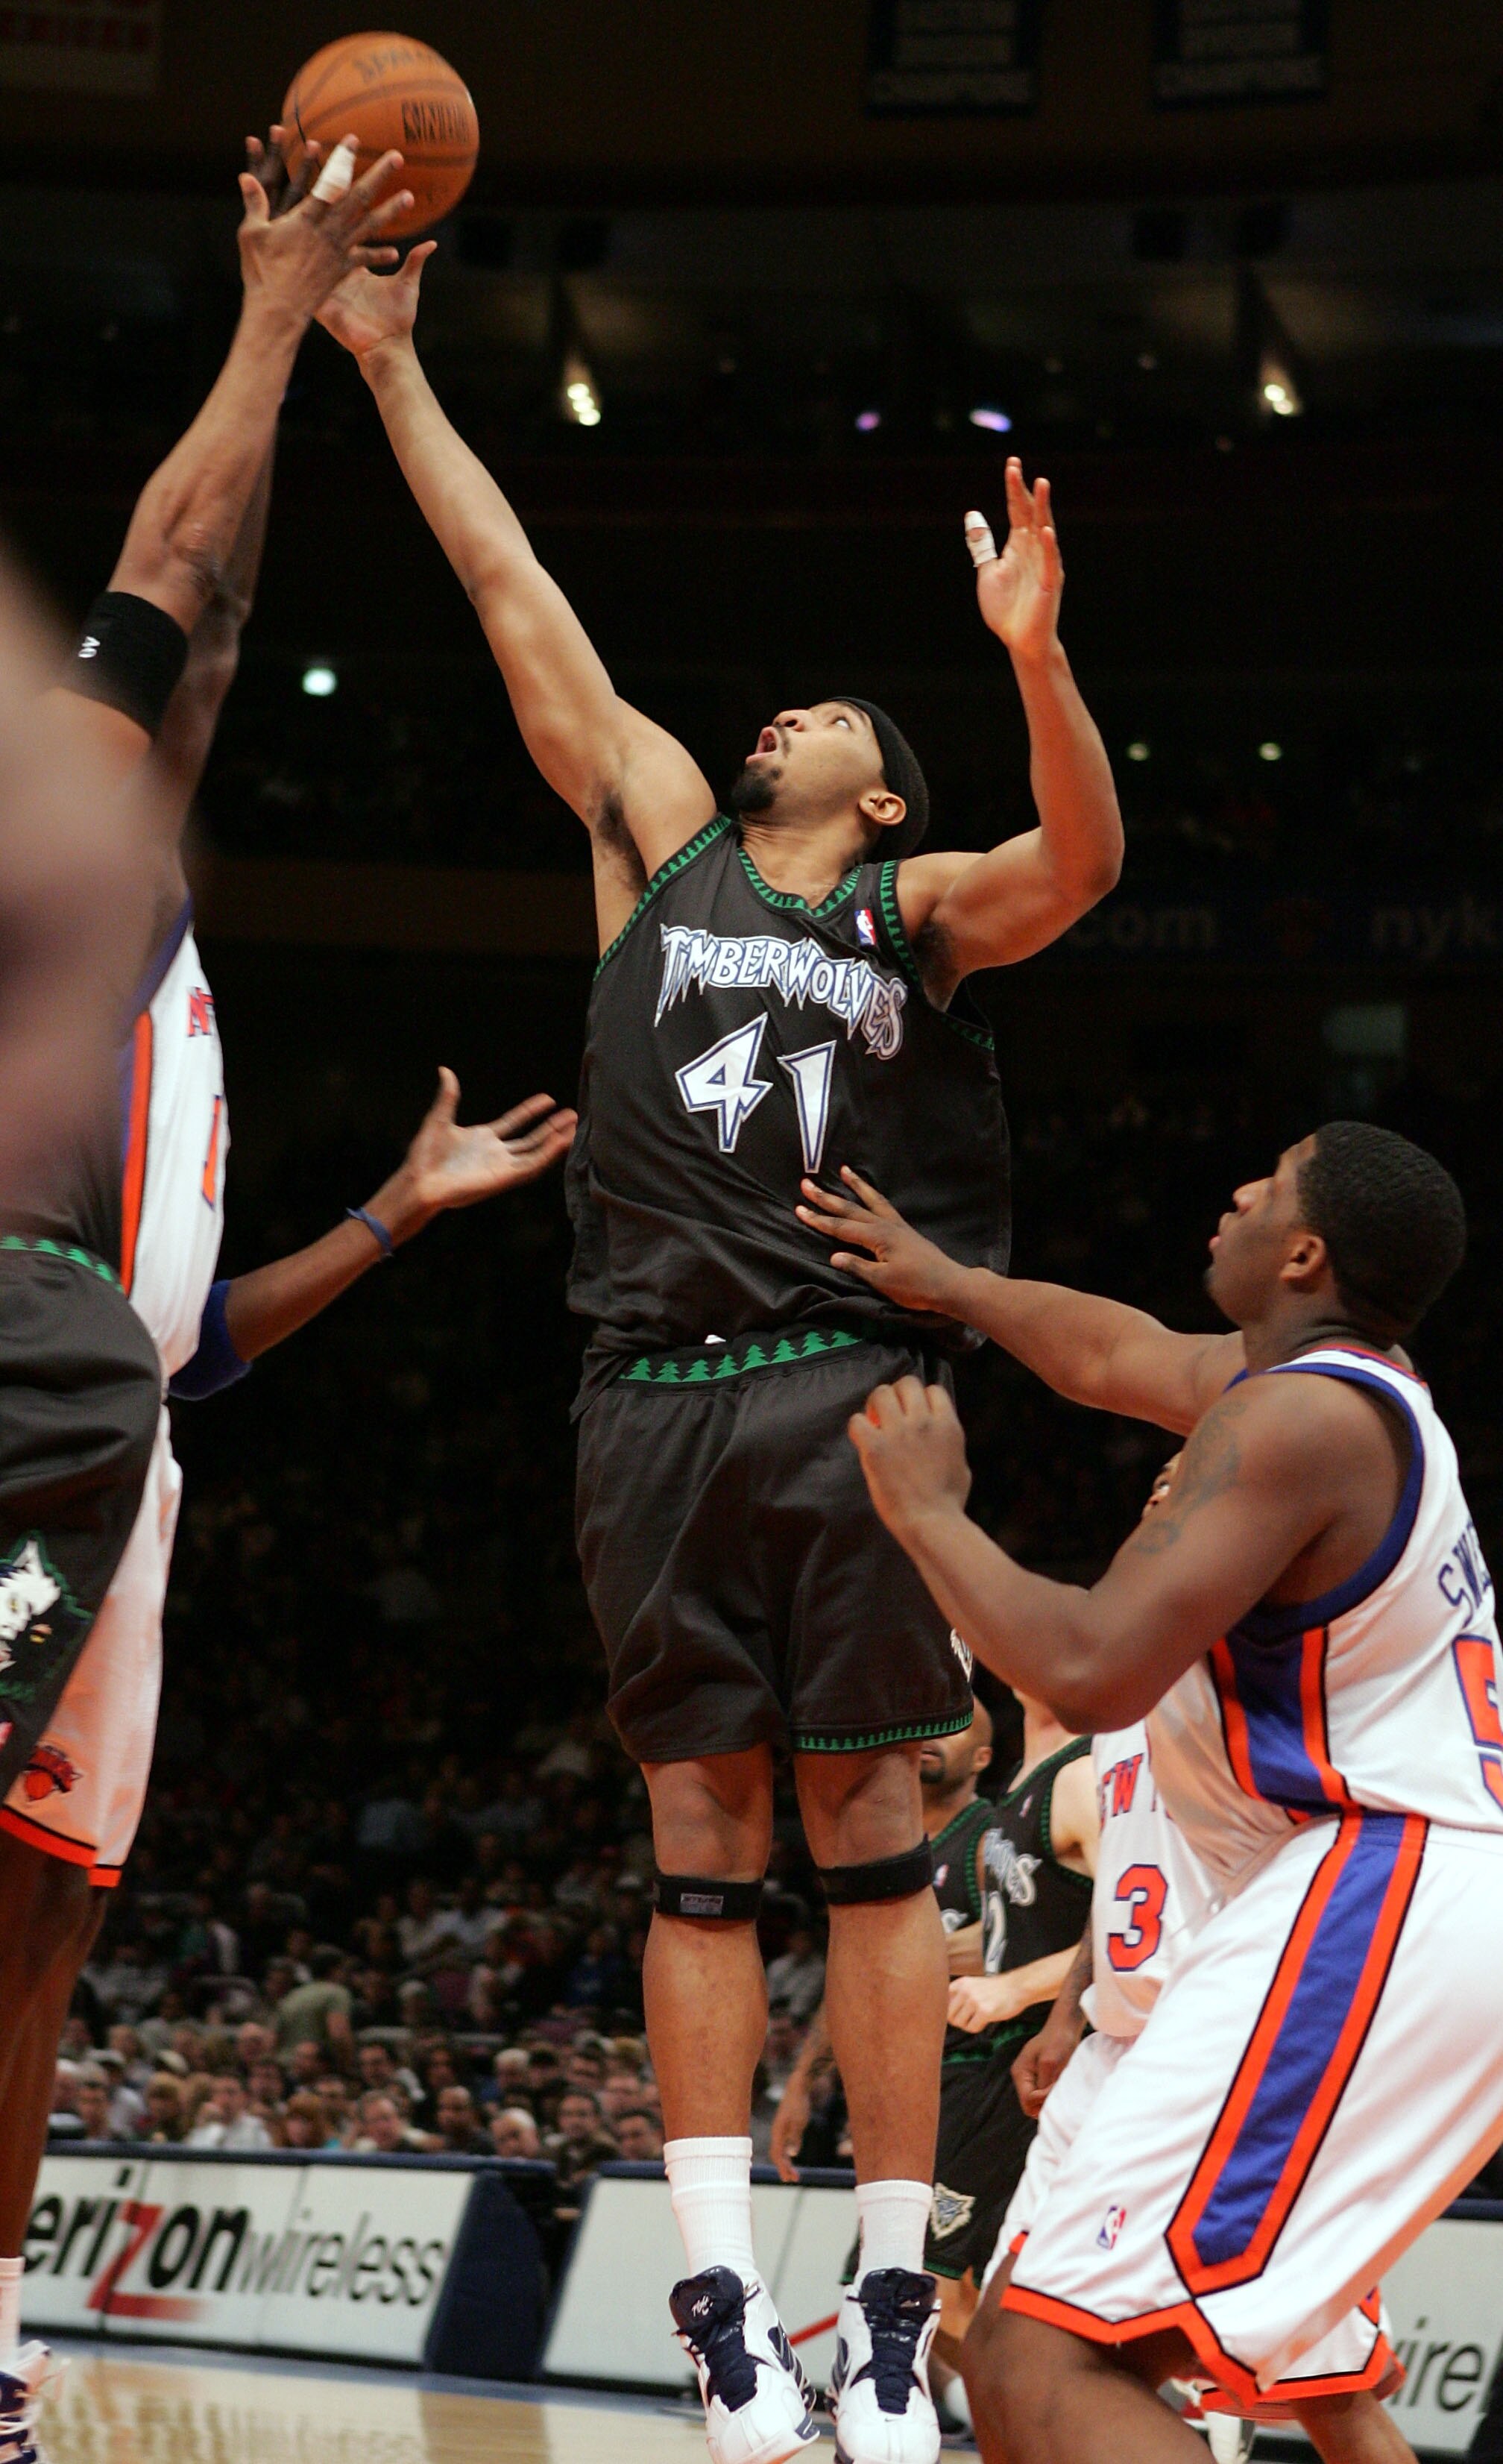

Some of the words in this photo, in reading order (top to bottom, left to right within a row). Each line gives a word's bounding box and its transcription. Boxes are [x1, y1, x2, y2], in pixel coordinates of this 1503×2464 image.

[654, 923, 908, 1060] TIMBERWOLVES
[675, 1011, 837, 1174] 41
[1106, 1863, 1169, 1973] 3
